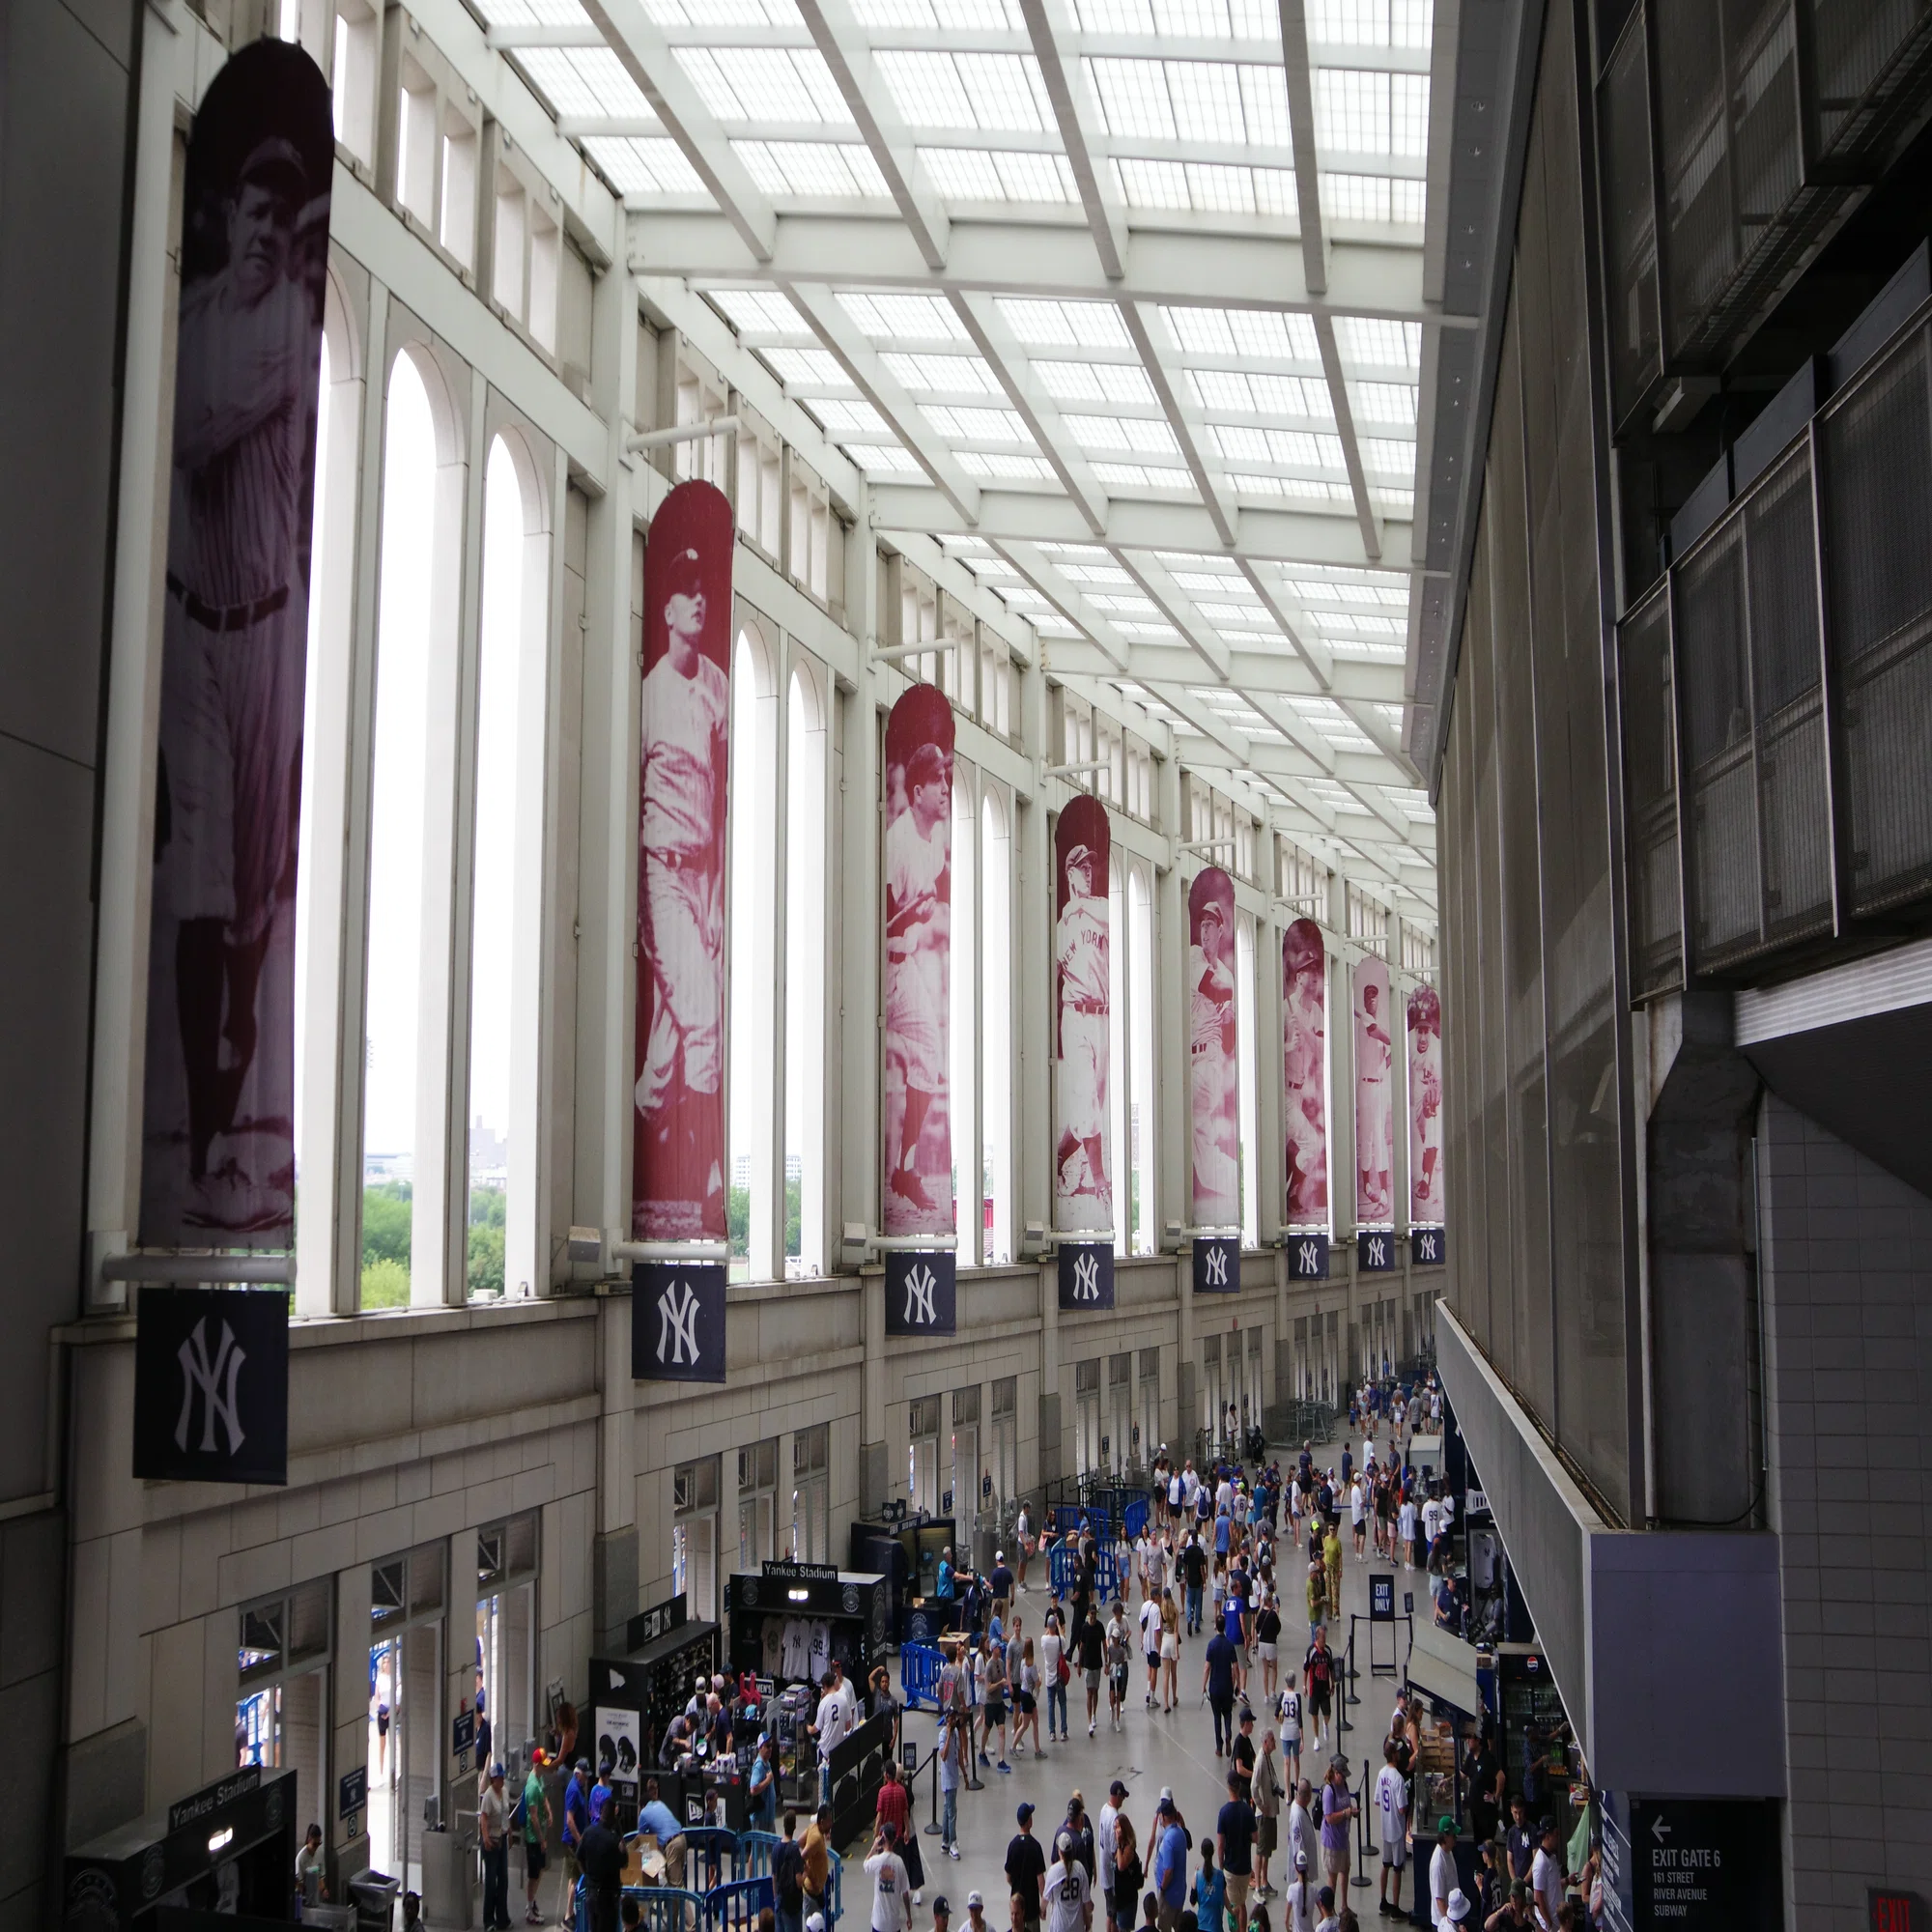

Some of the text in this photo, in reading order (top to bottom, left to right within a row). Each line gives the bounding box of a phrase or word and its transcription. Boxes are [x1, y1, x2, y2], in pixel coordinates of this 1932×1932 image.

[1062, 939, 1077, 969] NEW
[1429, 1510, 1437, 1521] 99
[764, 1565, 836, 1579] Yankee Stadium
[1376, 1583, 1388, 1597] EXIT
[1375, 1598, 1390, 1611] ONLY
[812, 1638, 823, 1656] 99
[943, 1682, 954, 1700] 17
[831, 1704, 838, 1722] 2
[1284, 1701, 1295, 1718] 03
[172, 1796, 213, 1829] Yankee
[216, 1772, 259, 1804] Stadium
[1383, 1789, 1390, 1812] 9
[1652, 1849, 1721, 1867] EXIT GATE 6
[1653, 1872, 1695, 1884] 161 STREET
[1654, 1888, 1708, 1901] RIVER AVENUE
[1654, 1904, 1688, 1917] SUBWAY
[1877, 1896, 1910, 1932] EXIT
